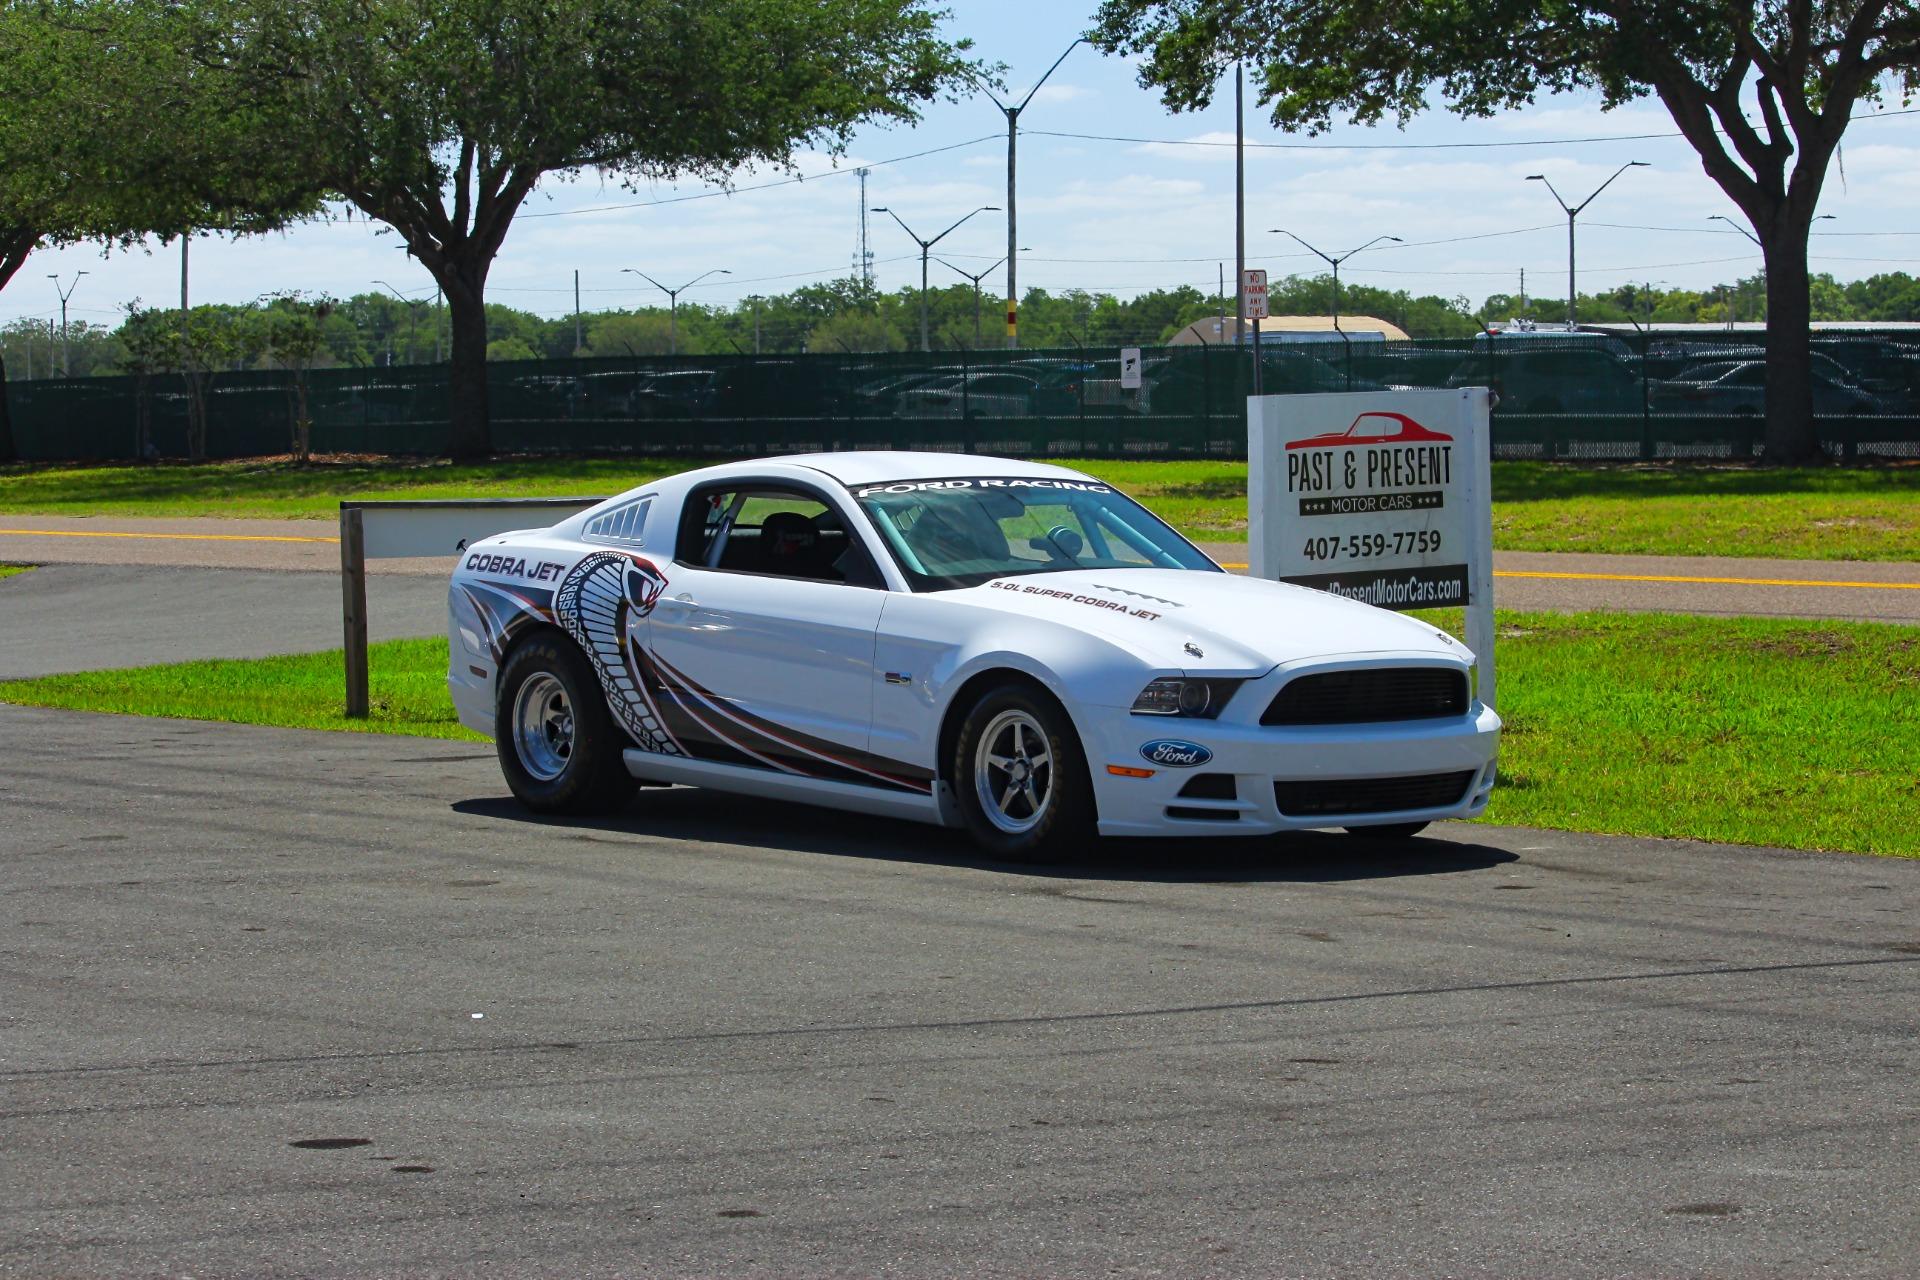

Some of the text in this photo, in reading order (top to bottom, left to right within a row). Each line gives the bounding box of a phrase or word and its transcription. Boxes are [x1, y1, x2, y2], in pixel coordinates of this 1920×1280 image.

[1288, 446, 1452, 492] PAST & PRESENT
[858, 480, 1111, 498] FORD RACING
[1331, 495, 1412, 512] MOTOR CARS
[1304, 530, 1441, 561] 407-559-7759
[466, 554, 566, 582] COBRA JET
[990, 581, 1161, 622] 5.0L SUPER COBRA JET
[1153, 742, 1196, 764] Ford
